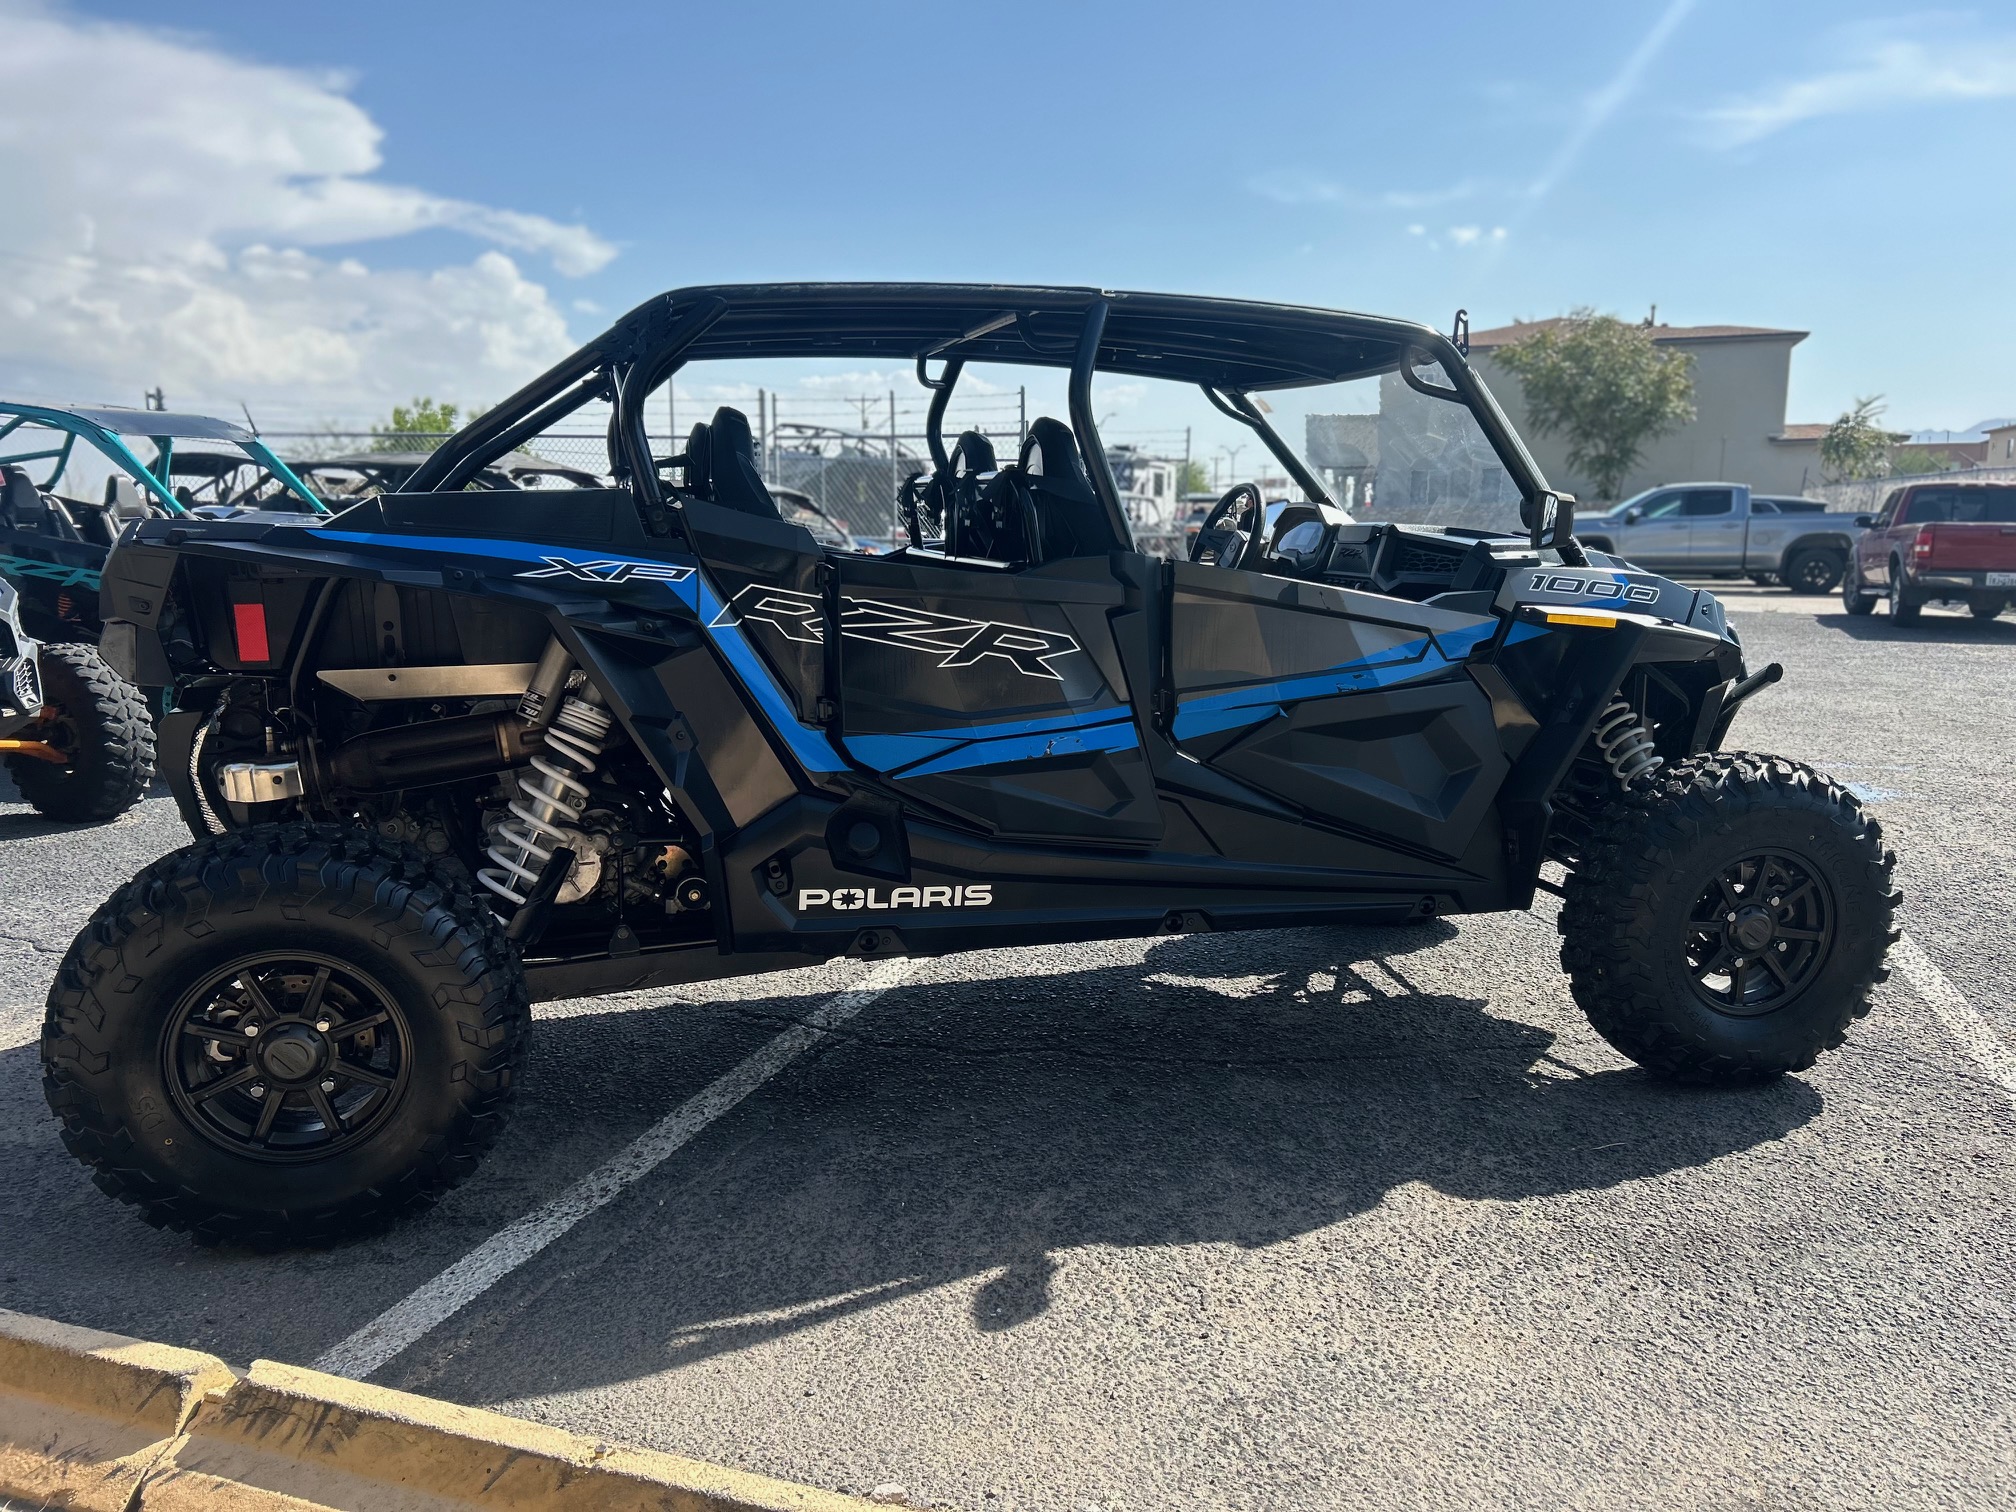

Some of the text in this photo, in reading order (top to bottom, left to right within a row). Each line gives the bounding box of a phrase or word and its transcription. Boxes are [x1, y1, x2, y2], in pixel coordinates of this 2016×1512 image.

[512, 555, 697, 583] XP
[1528, 573, 1660, 604] 1000
[707, 583, 1081, 681] RZR
[798, 884, 993, 911] POLARIS
